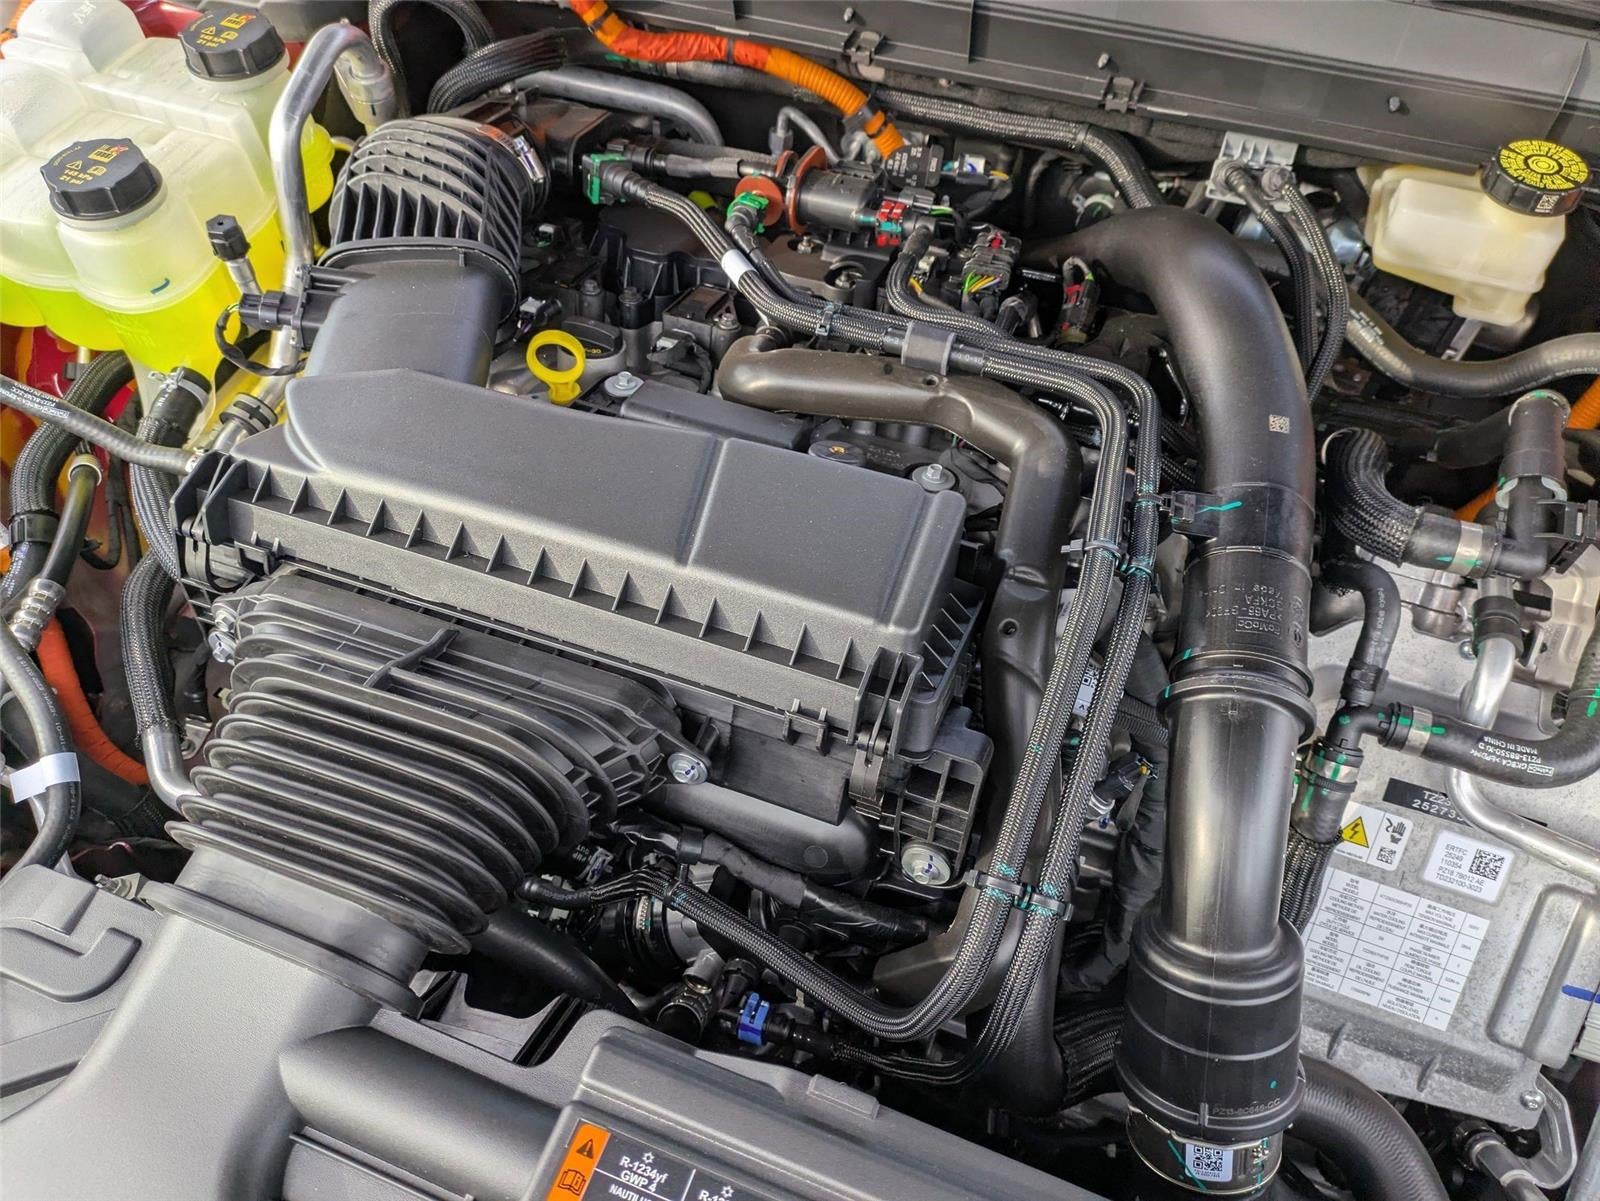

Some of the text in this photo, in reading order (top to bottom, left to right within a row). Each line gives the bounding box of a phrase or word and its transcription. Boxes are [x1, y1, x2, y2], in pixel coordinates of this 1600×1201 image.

[1482, 735, 1506, 746] CHINA
[1515, 743, 1537, 754] MADE
[619, 1156, 669, 1184] R-1234yf
[620, 1170, 649, 1187] GWP
